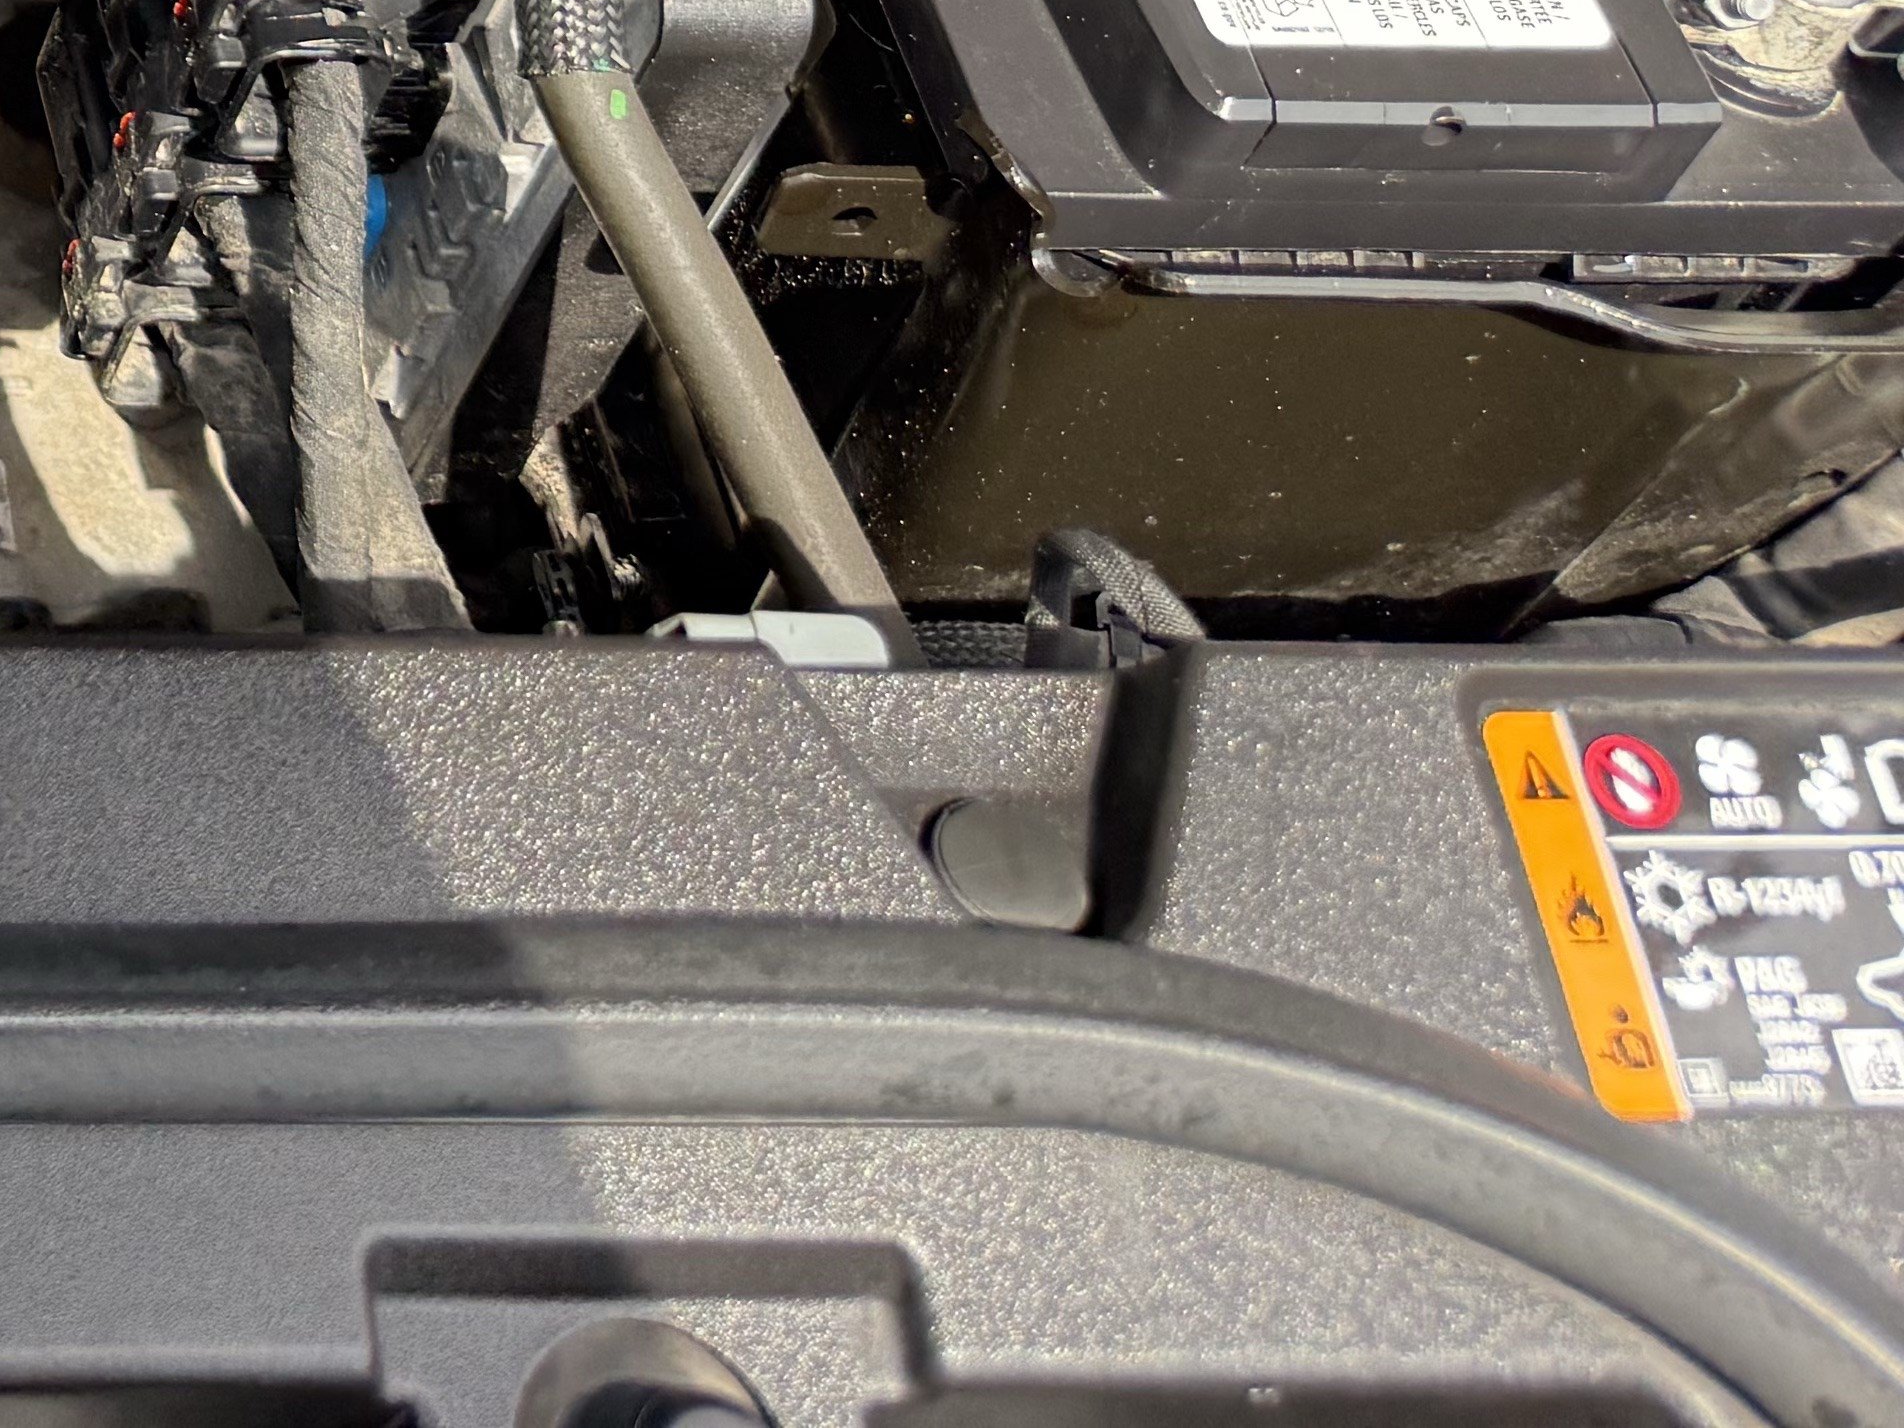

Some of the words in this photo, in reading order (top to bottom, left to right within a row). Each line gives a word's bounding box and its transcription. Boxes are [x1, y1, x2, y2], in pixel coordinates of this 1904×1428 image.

[1370, 8, 1393, 28] LOS
[1486, 0, 1510, 20] LOS
[1709, 795, 1783, 830] AUTO
[1733, 955, 1808, 993] PAG
